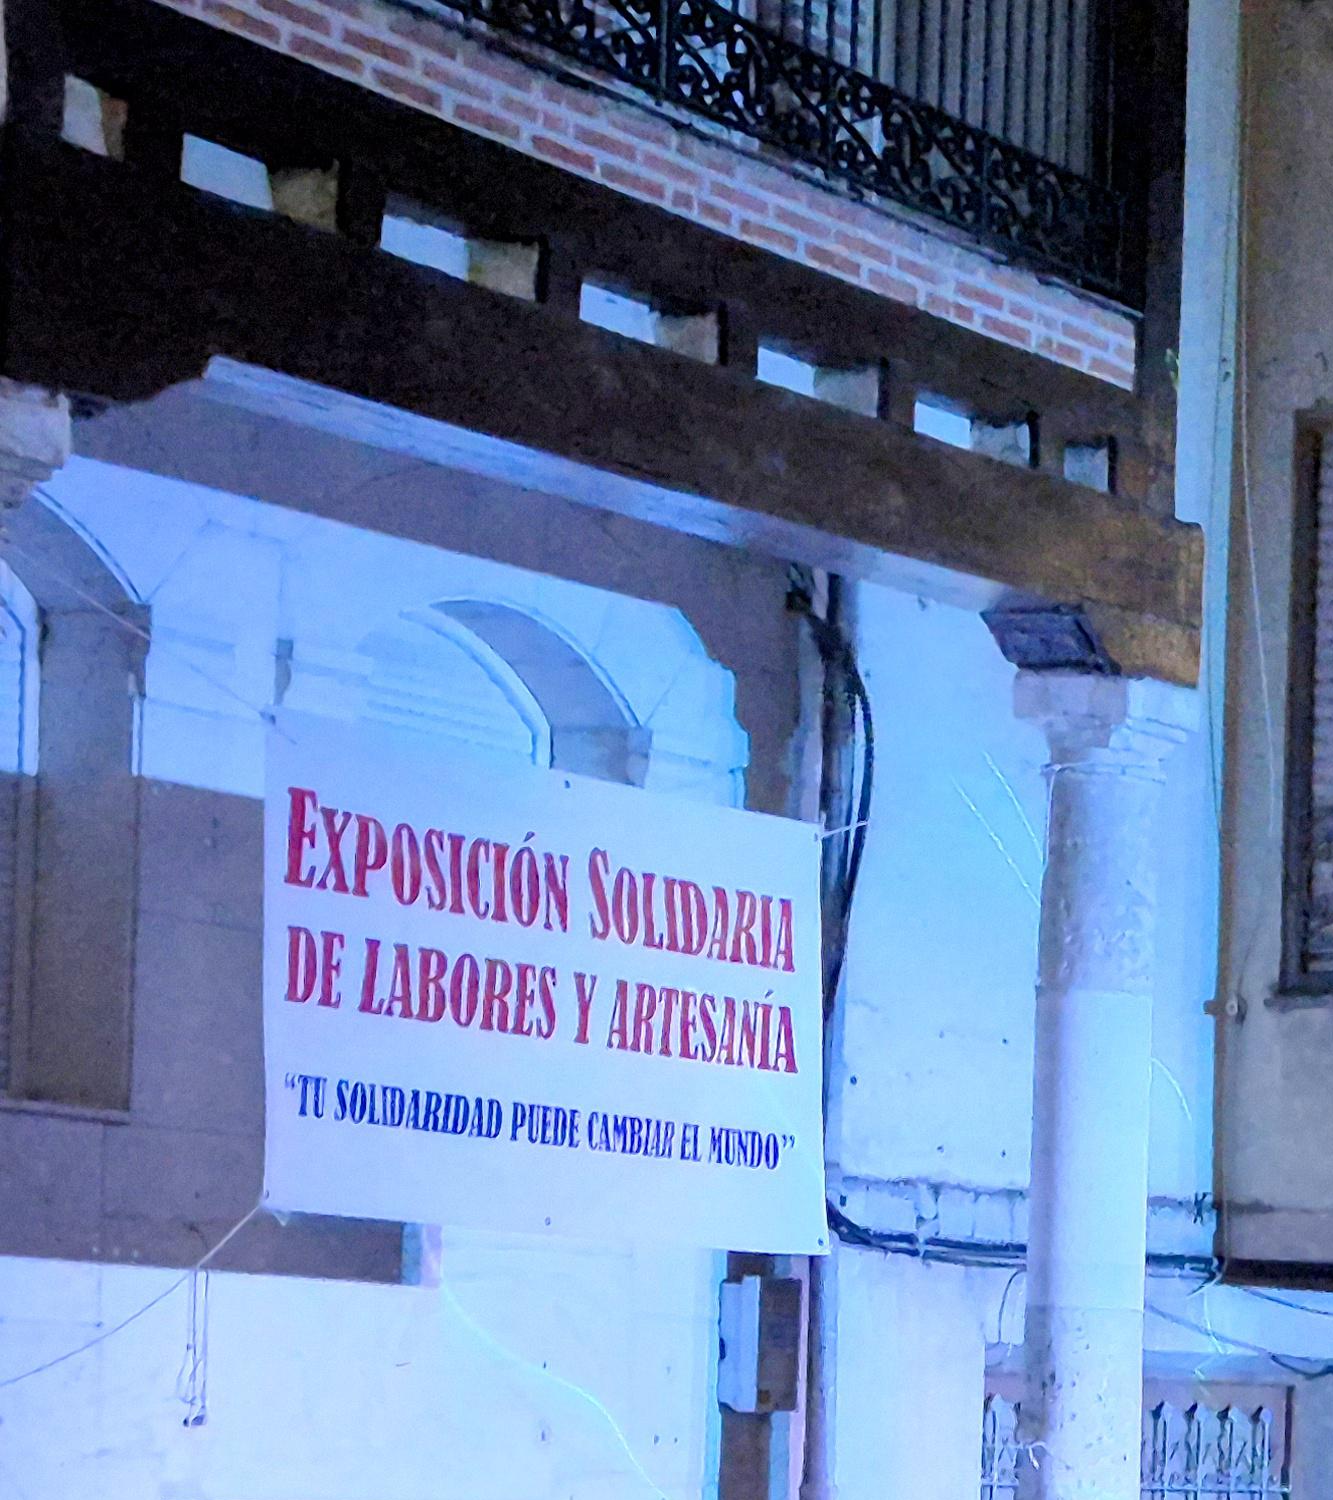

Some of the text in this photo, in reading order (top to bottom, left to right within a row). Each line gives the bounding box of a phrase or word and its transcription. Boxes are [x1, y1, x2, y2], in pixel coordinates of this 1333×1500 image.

[284, 786, 797, 973] EXPOSICIÓN SOLIDARIA
[284, 925, 799, 1074] DE LABORES Y ARTESANÍA
[333, 1078, 503, 1140] SOLIDARIDAD
[510, 1101, 581, 1149] PUEDE
[587, 1112, 675, 1160] CAMBIAR
[679, 1122, 703, 1163] EL
